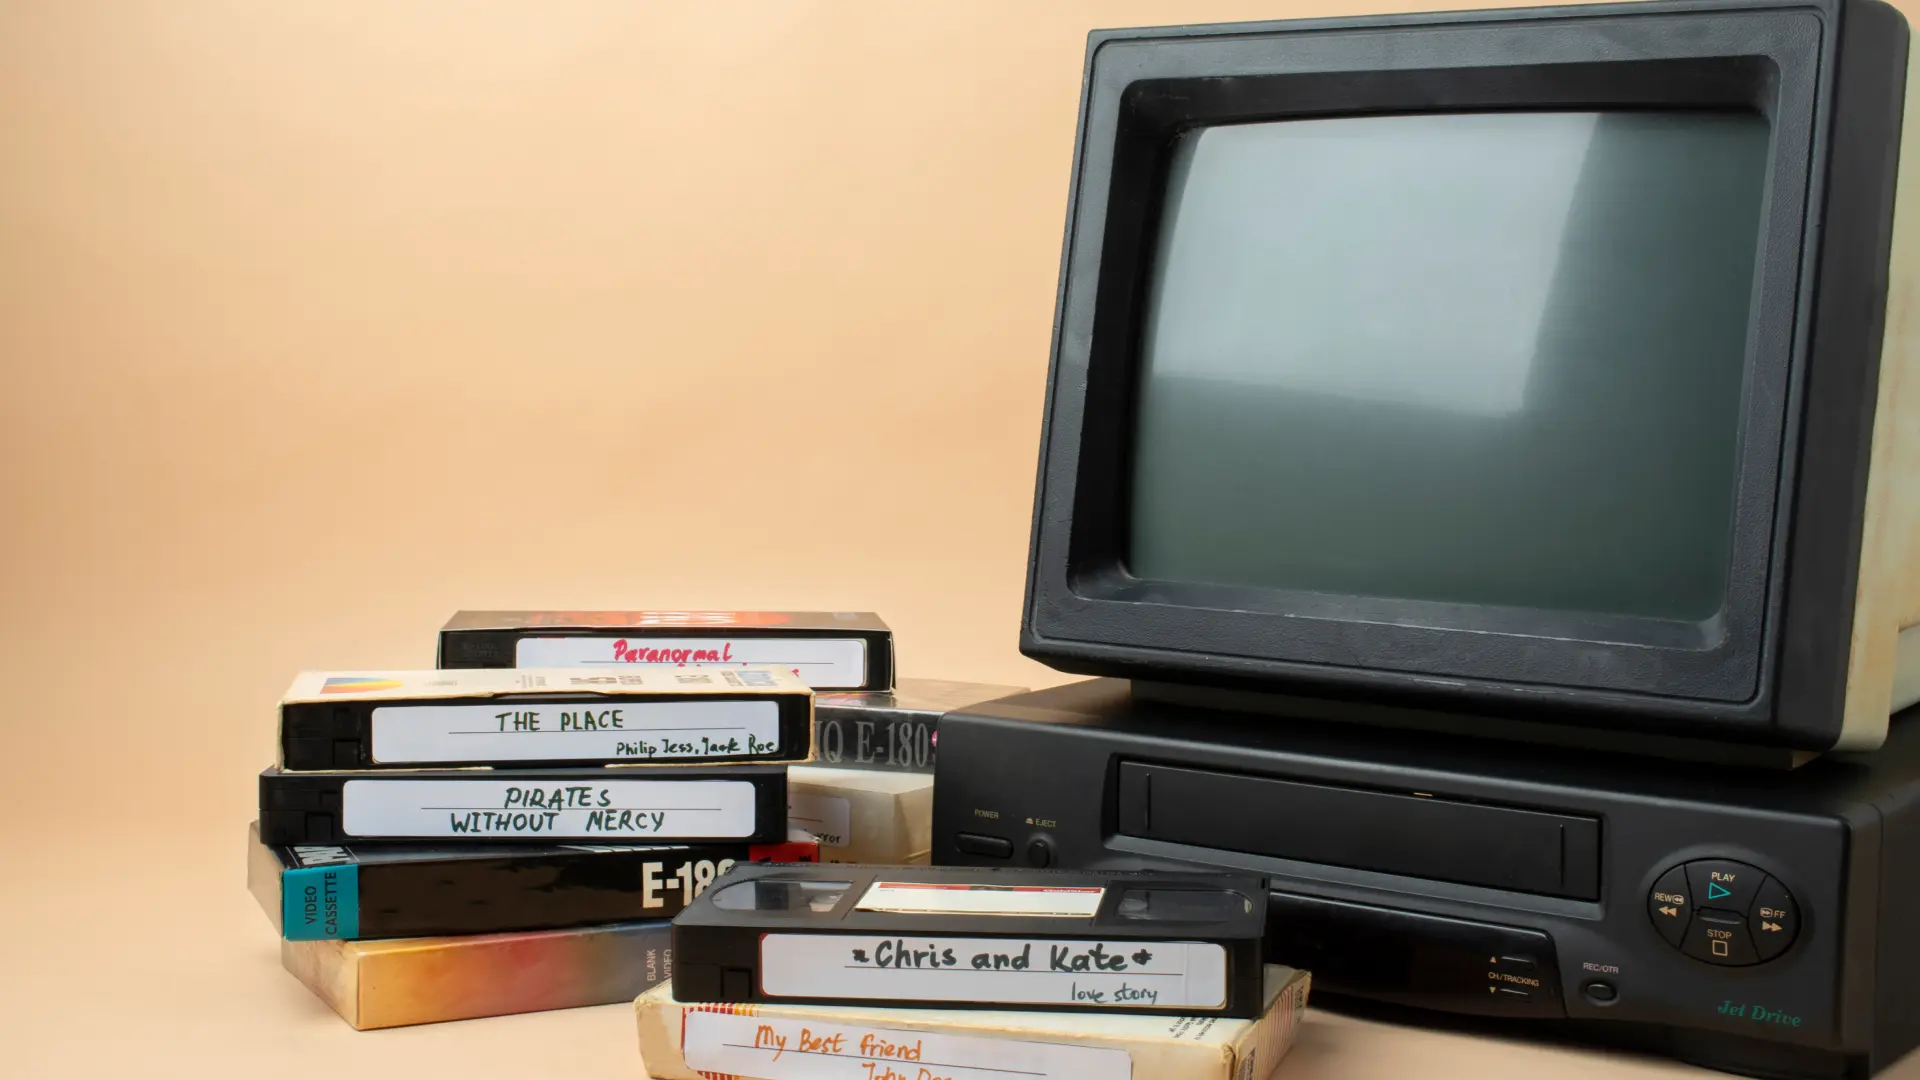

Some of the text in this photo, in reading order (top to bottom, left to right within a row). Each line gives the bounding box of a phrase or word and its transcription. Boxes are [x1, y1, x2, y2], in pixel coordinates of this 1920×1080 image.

[613, 638, 733, 662] Paranormal
[495, 709, 624, 731] THE PLACE
[616, 741, 657, 758] Philip
[748, 733, 775, 756] Roe
[855, 721, 929, 768] E-180
[503, 786, 612, 811] PIRATES
[450, 808, 665, 833] WITHOUT MERCY
[974, 808, 999, 819] POWER
[1035, 818, 1057, 828] EJECT
[1711, 871, 1736, 883] PLAY
[304, 886, 318, 925] VIDEO
[324, 872, 338, 935] CASSETTE
[1654, 892, 1673, 903] REW
[1774, 910, 1786, 919] FF
[1707, 928, 1732, 939] STOP
[646, 948, 657, 982] BLANK
[875, 939, 1128, 972] Chris and Kate
[1583, 962, 1619, 975] REC/OTR
[1072, 981, 1158, 1005] love story
[1717, 1000, 1801, 1027] Jet Drive
[755, 1024, 787, 1062] My
[800, 1028, 848, 1054] Best
